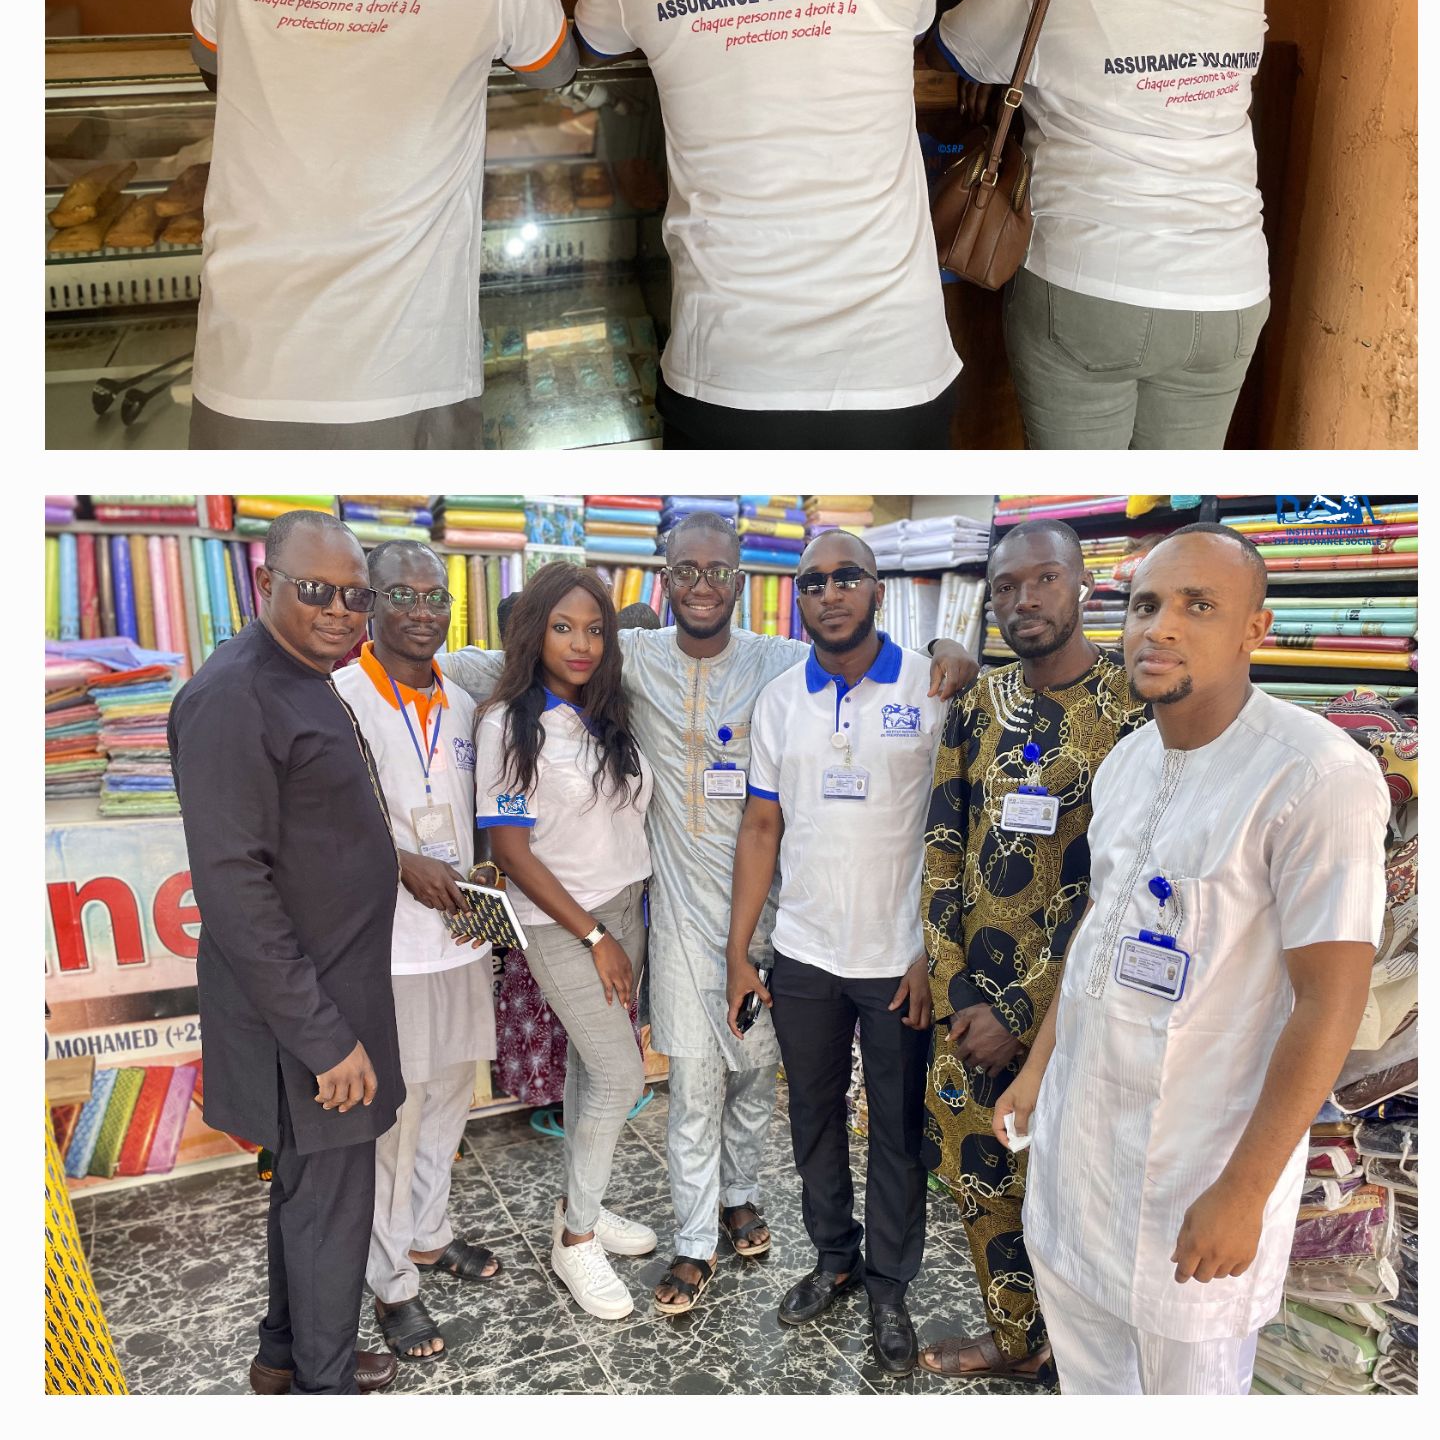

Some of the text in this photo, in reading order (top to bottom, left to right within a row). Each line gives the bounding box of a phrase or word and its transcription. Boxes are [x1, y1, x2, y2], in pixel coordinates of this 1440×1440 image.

[355, 2, 363, 12] a
[409, 0, 421, 15] la
[691, 16, 734, 34] Chaque
[736, 10, 792, 29] personne
[794, 9, 801, 19] a
[804, 2, 836, 18] droit
[847, 0, 857, 15] la
[277, 15, 389, 33] protection sociale
[725, 20, 832, 51] protection sociale
[1104, 52, 1198, 75] ASSURANCE
[1136, 77, 1176, 92] Chaque
[1177, 72, 1219, 90] personne
[1165, 89, 1215, 108] protection
[55, 1027, 159, 1061] MOHAMED
